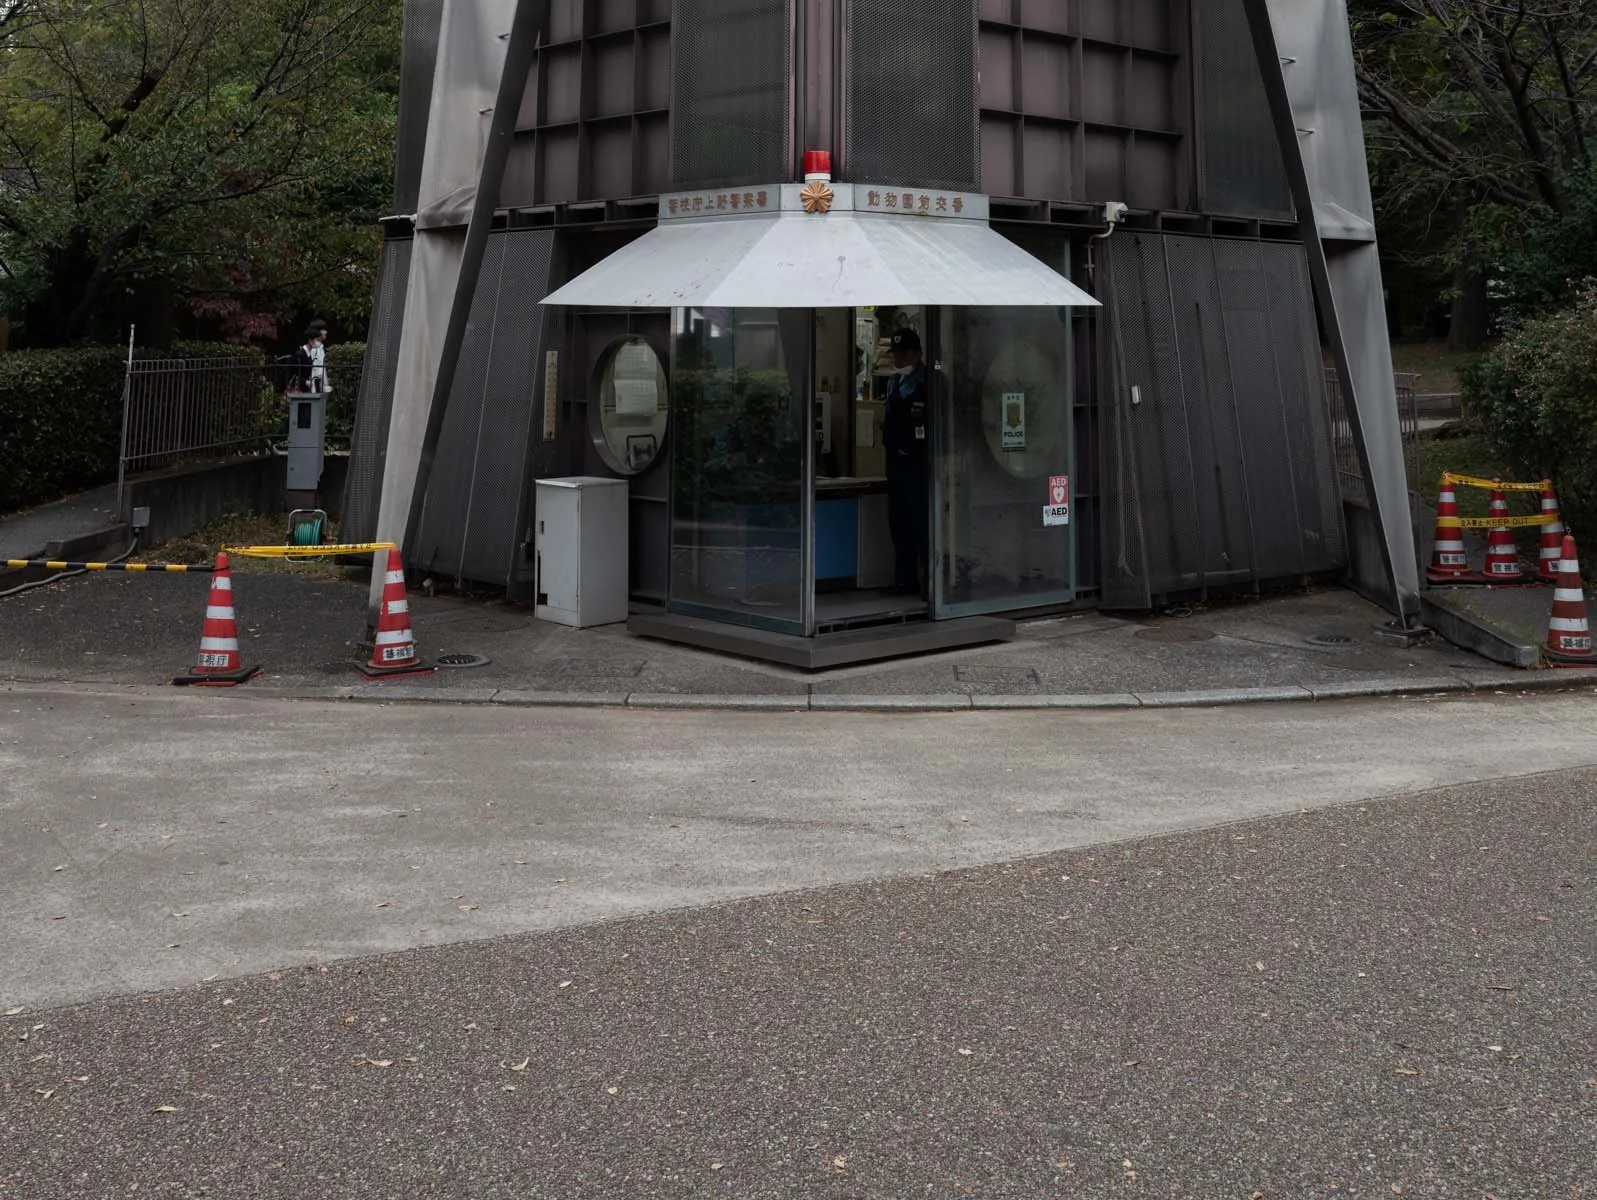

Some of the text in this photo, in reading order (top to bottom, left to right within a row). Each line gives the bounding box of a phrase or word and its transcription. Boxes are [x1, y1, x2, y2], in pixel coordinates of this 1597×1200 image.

[1051, 478, 1066, 487] AED
[1051, 507, 1067, 516] AED
[1486, 518, 1509, 526] KEEP
